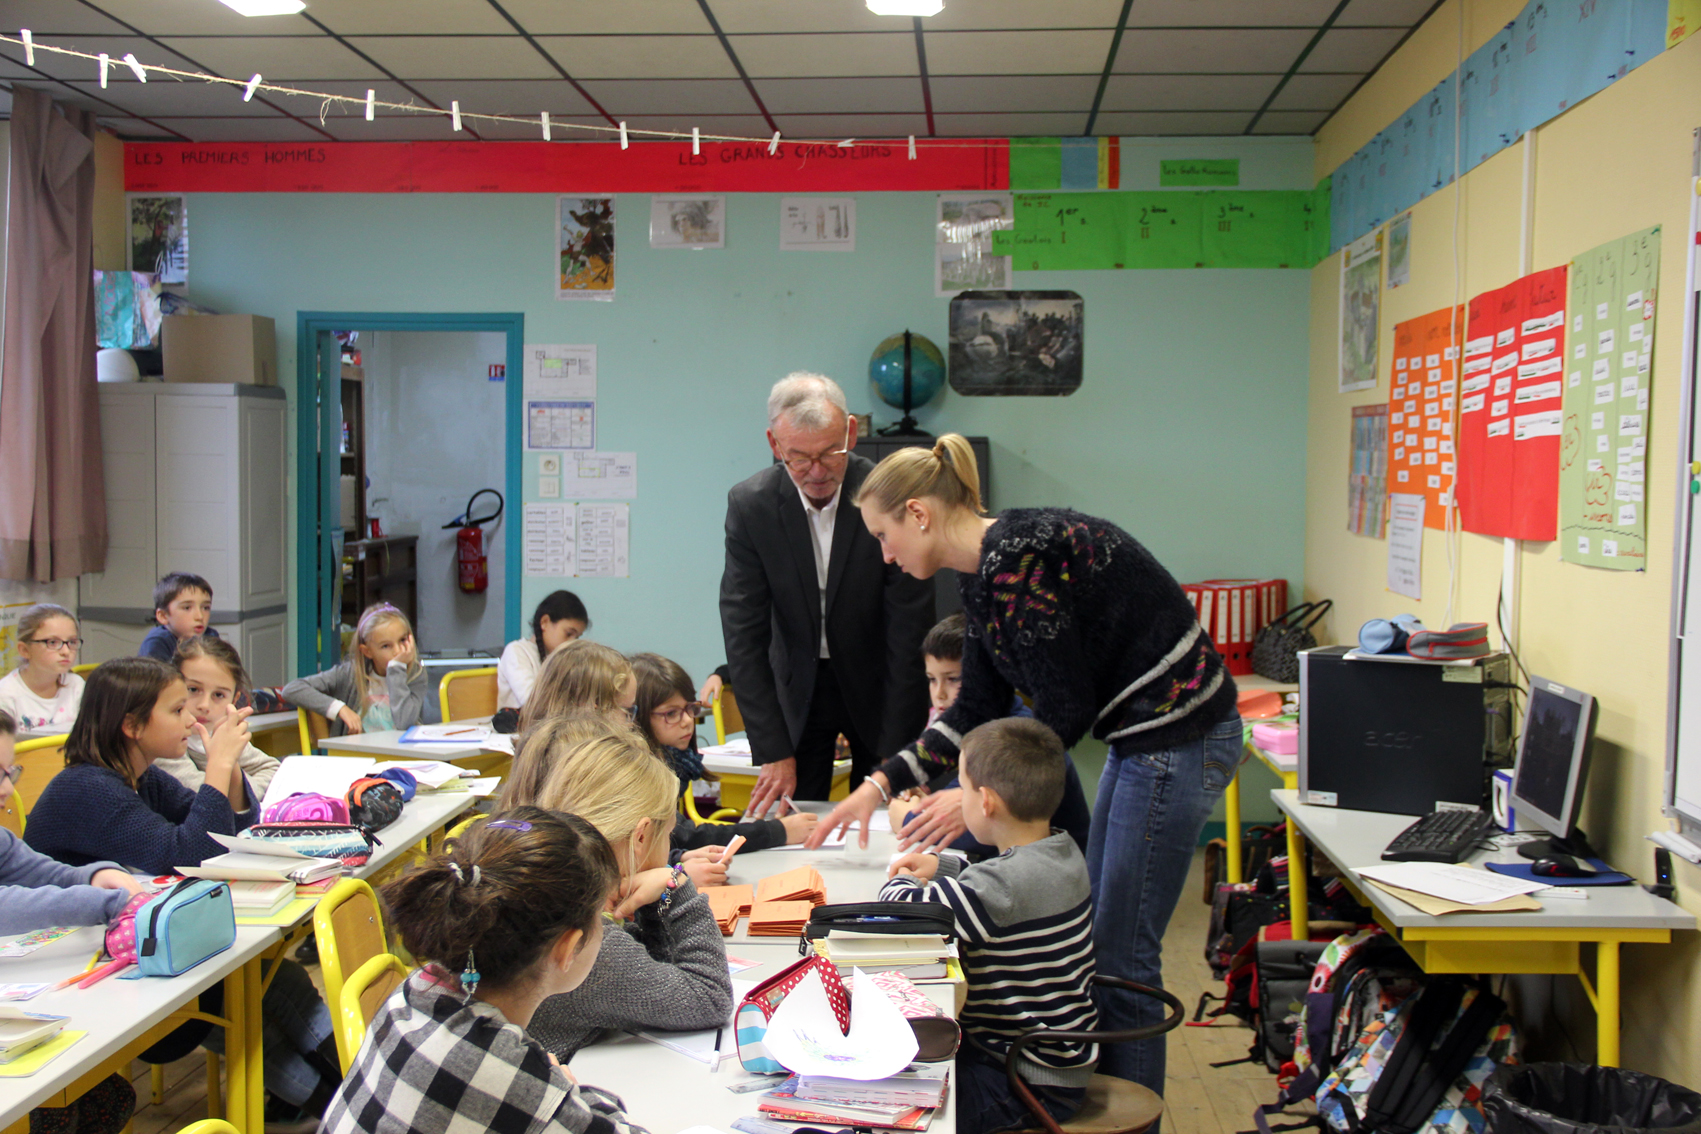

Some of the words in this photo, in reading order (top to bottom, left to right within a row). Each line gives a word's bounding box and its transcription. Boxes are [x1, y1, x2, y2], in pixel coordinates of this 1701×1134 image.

[135, 152, 163, 165] LES
[181, 151, 250, 164] PREMIERS
[264, 148, 326, 164] HOMMES
[678, 150, 708, 166] LES
[794, 144, 892, 160] CHASSEURS
[1365, 731, 1422, 749] acer
